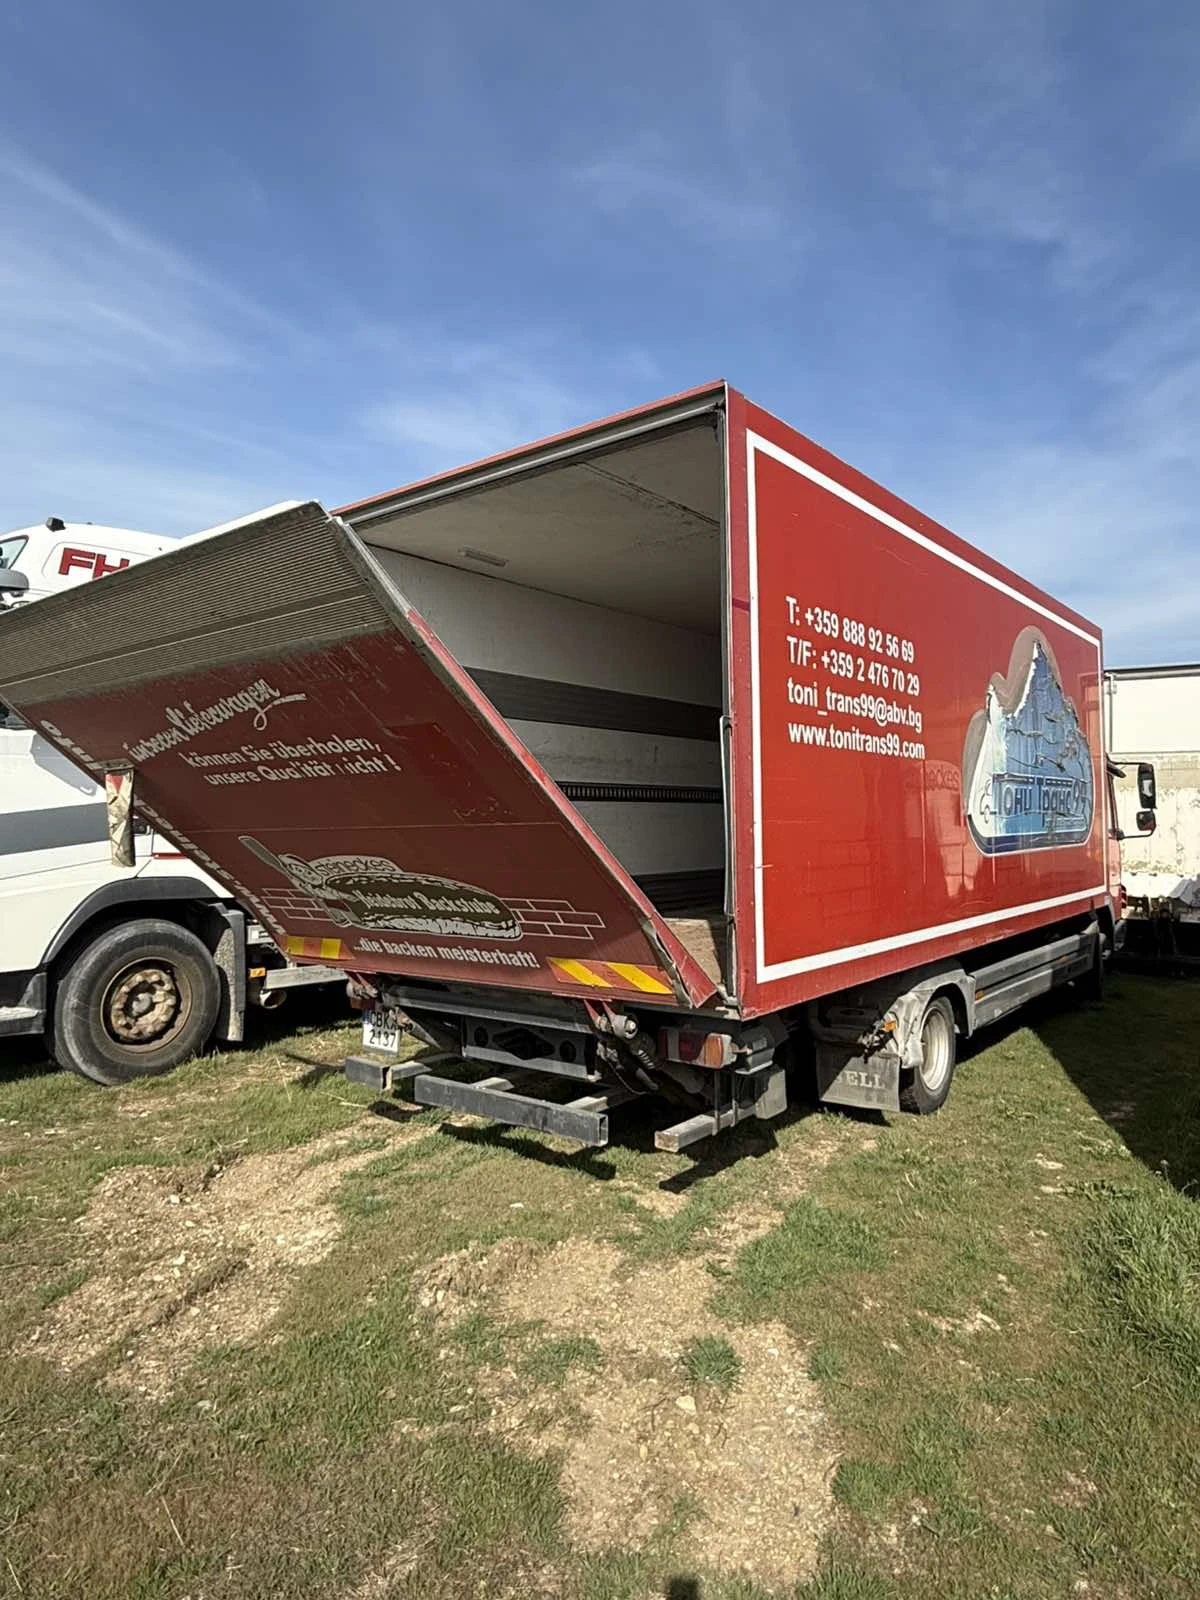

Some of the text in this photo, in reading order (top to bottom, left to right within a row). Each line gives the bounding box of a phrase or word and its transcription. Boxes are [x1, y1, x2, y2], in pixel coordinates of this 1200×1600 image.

[786, 595, 915, 663] T: +359 888 92 56 69
[787, 635, 920, 696] T/F: +359 2 476 70 29
[787, 677, 922, 733] toni_trans99@abv.bg
[178, 733, 382, 768] können Sie überholen,
[788, 722, 925, 760] www.tonitrans99.com
[203, 771, 261, 785] unsere
[380, 938, 438, 958] backen
[436, 945, 540, 968] meisterhaft!
[369, 1028, 396, 1048] 2137
